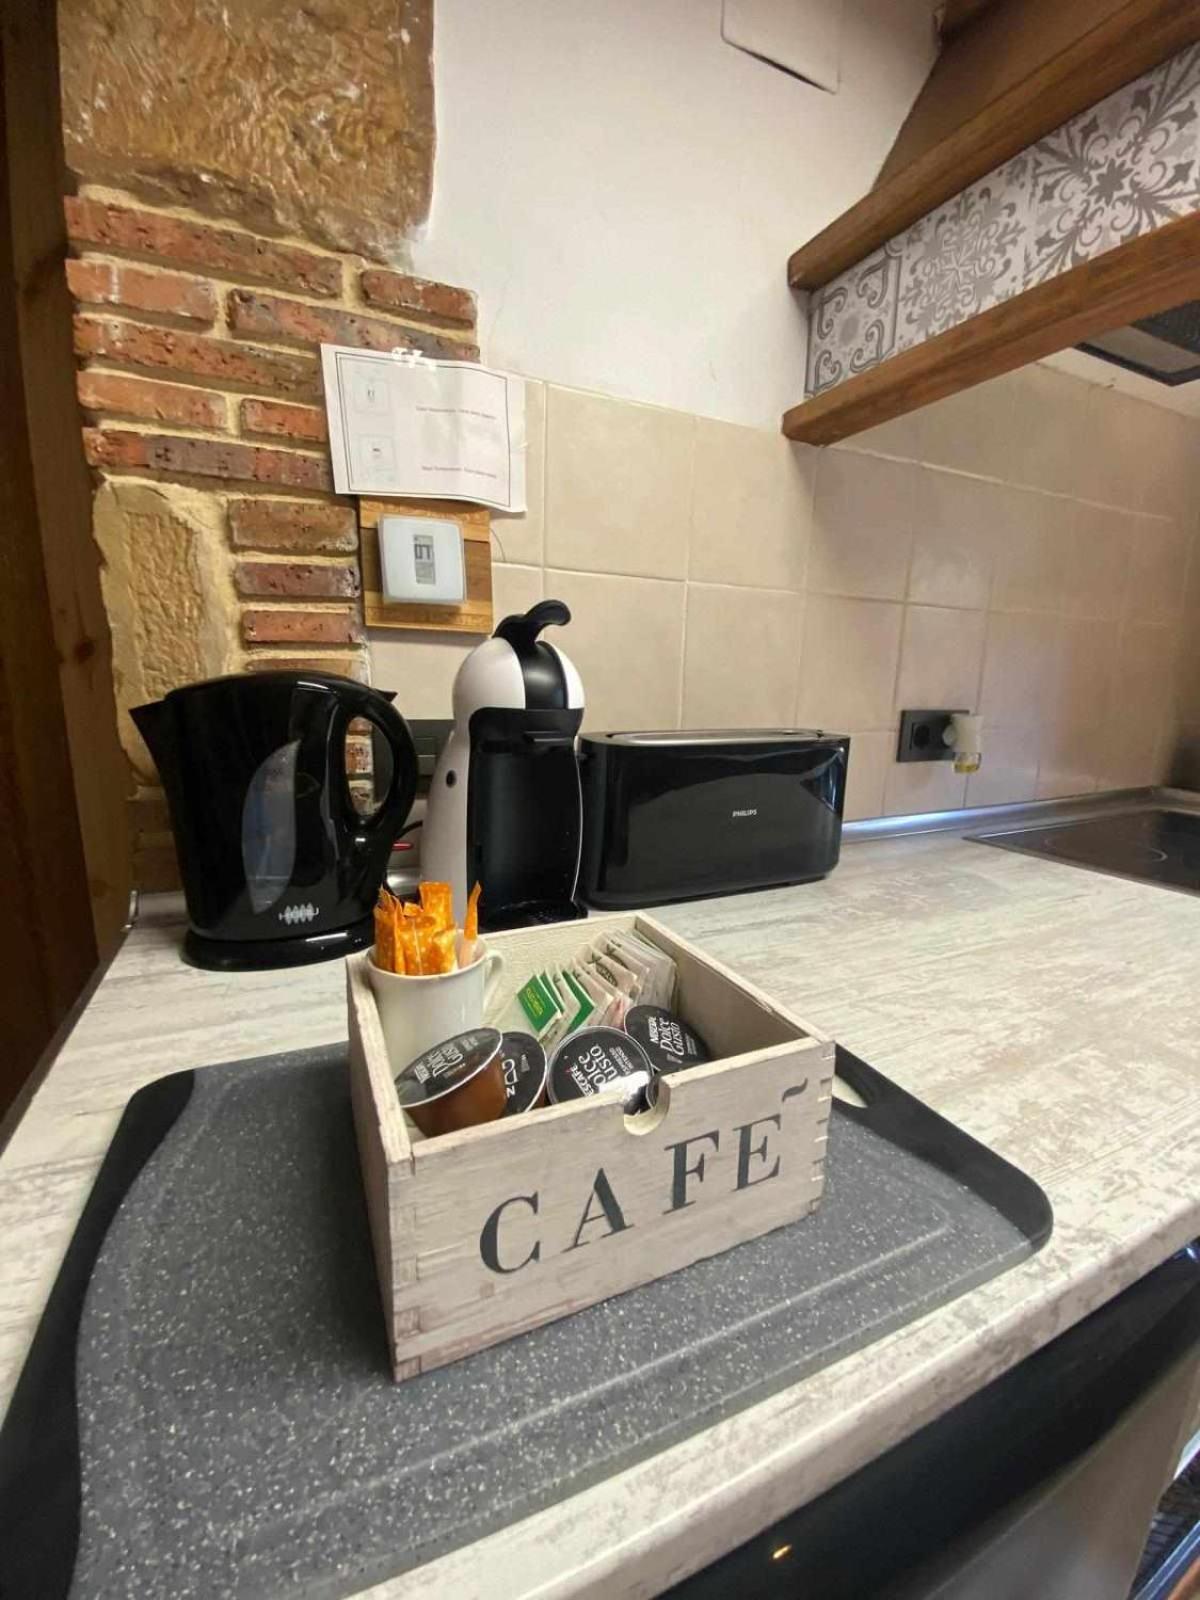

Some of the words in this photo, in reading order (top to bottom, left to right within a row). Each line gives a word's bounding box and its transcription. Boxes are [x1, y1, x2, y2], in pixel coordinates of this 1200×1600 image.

[732, 809, 757, 817] PHILIPS
[578, 1052, 606, 1086] olce
[590, 1043, 618, 1081] usto
